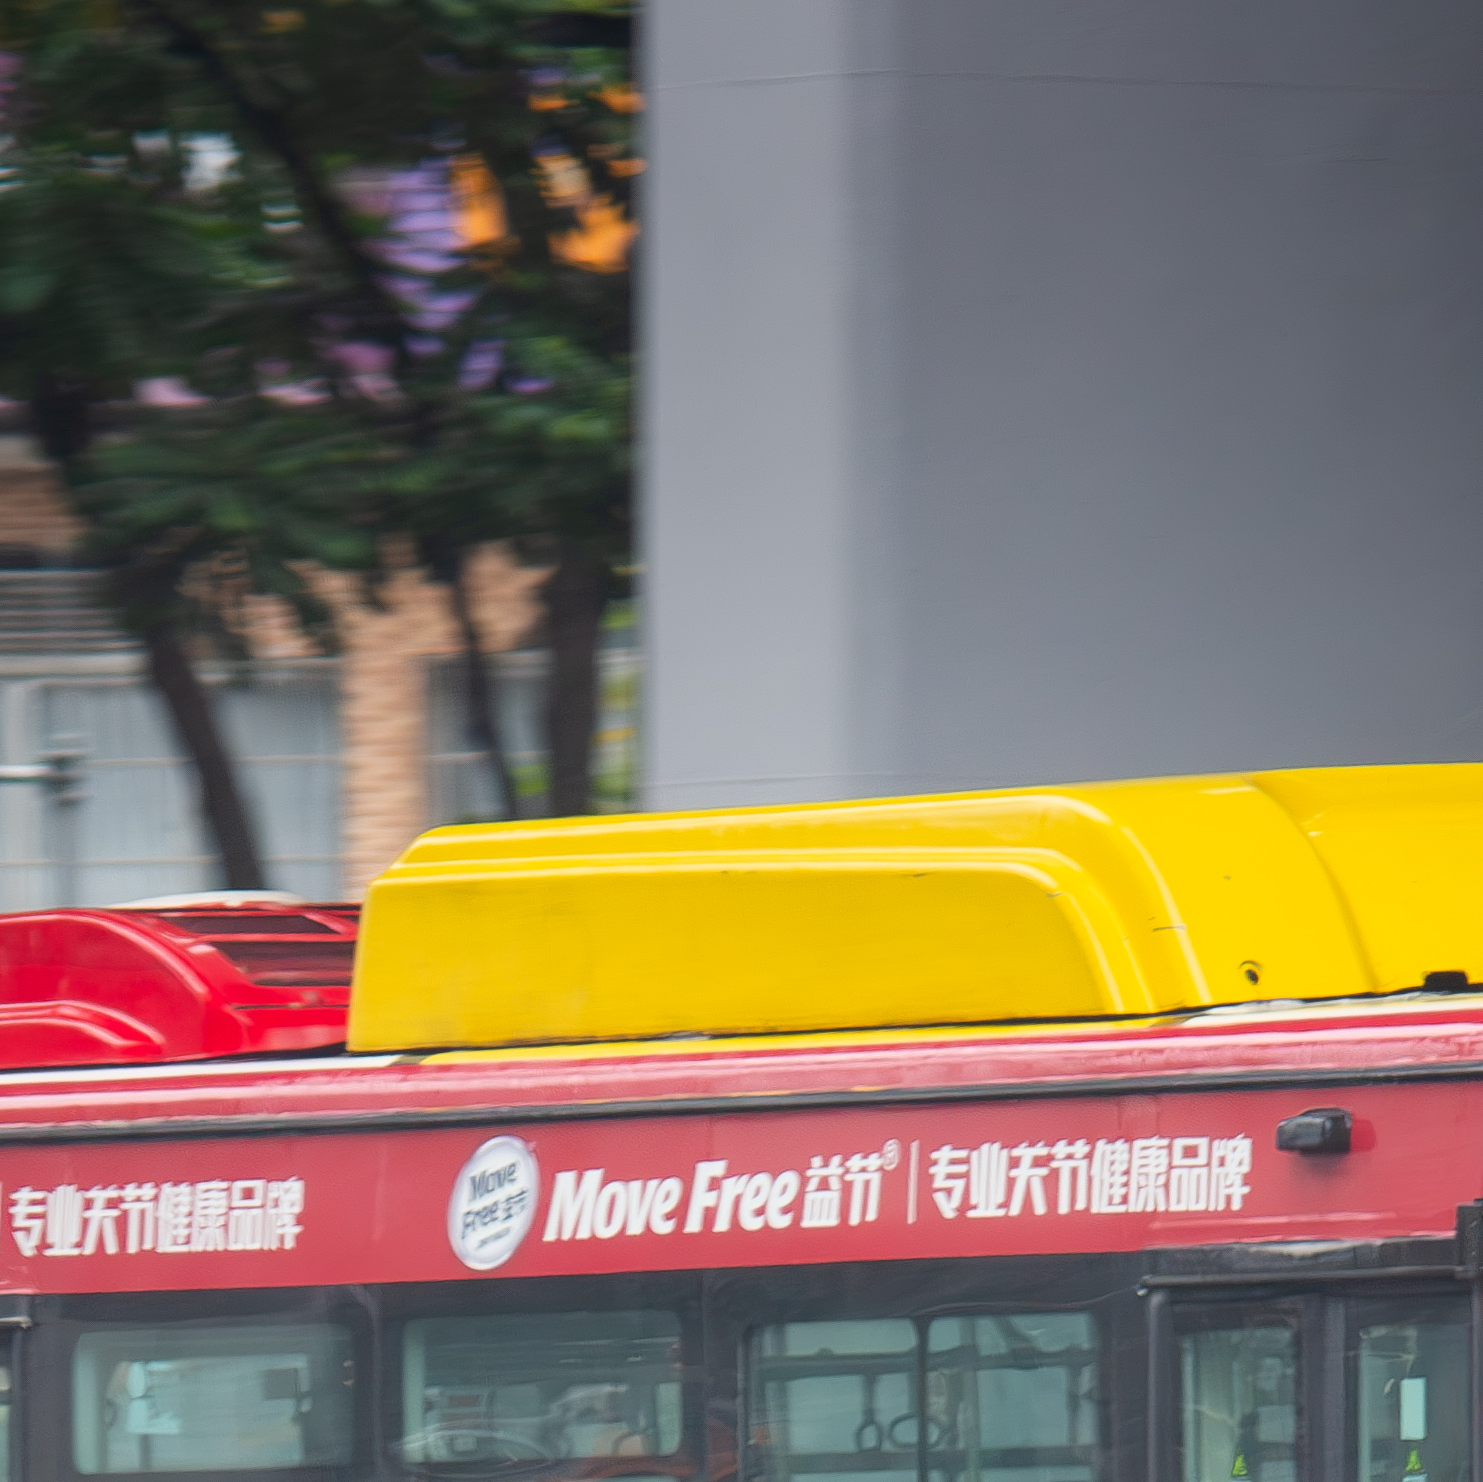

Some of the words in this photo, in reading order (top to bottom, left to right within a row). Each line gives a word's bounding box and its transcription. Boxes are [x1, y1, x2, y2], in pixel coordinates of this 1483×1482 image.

[9, 1176, 305, 1258] 专业关节健康品牌
[543, 1163, 681, 1242] Move
[683, 1159, 799, 1233] Free
[927, 1133, 1252, 1220] 专业关节健康品牌
